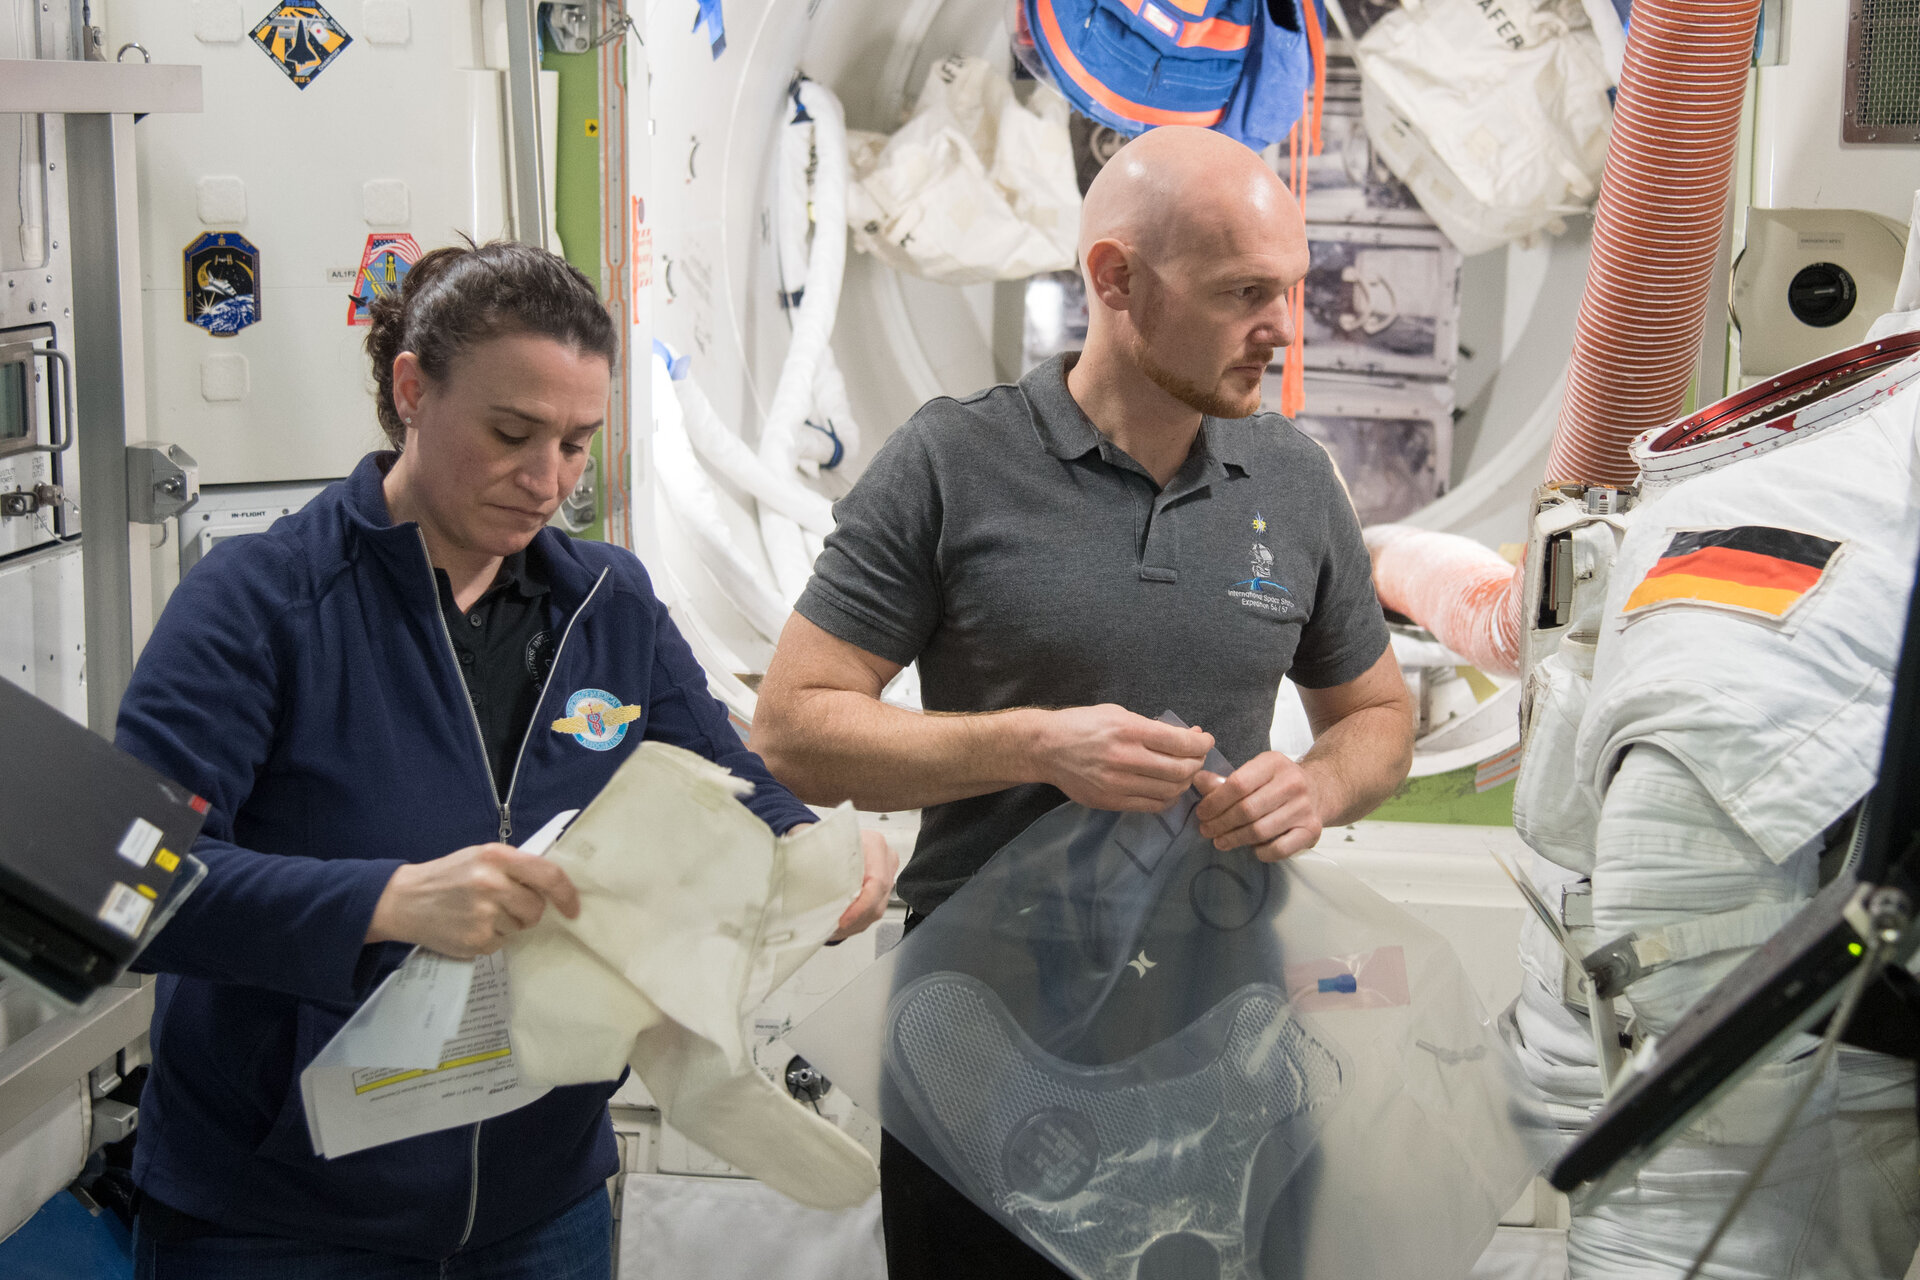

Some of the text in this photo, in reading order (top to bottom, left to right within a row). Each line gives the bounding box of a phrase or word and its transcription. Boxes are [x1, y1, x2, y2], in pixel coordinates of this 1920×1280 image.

[269, 6, 282, 19] KELLY
[1227, 590, 1263, 600] International
[1241, 598, 1270, 610] Expedition
